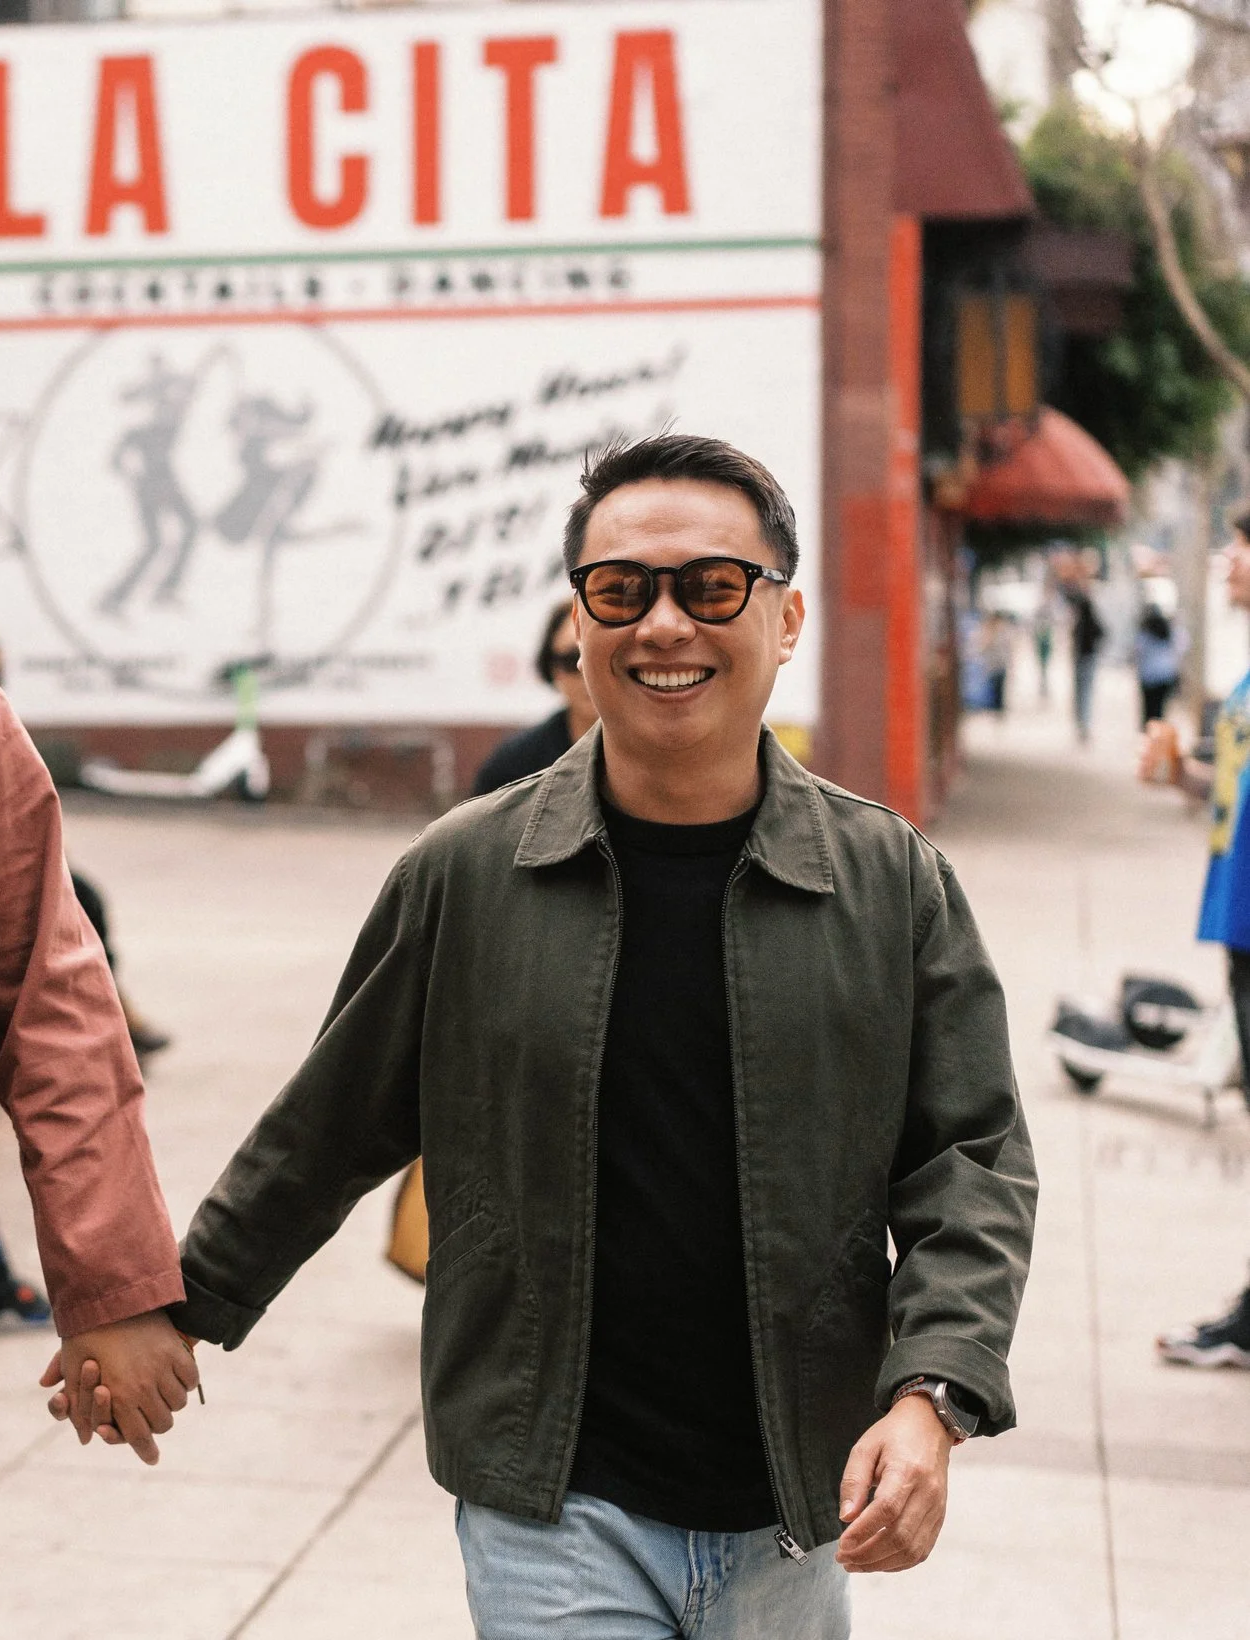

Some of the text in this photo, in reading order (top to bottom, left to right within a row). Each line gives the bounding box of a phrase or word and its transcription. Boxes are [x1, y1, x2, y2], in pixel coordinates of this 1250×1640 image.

[285, 30, 693, 231] CITA
[36, 258, 632, 310] COCKTAILS DANCING
